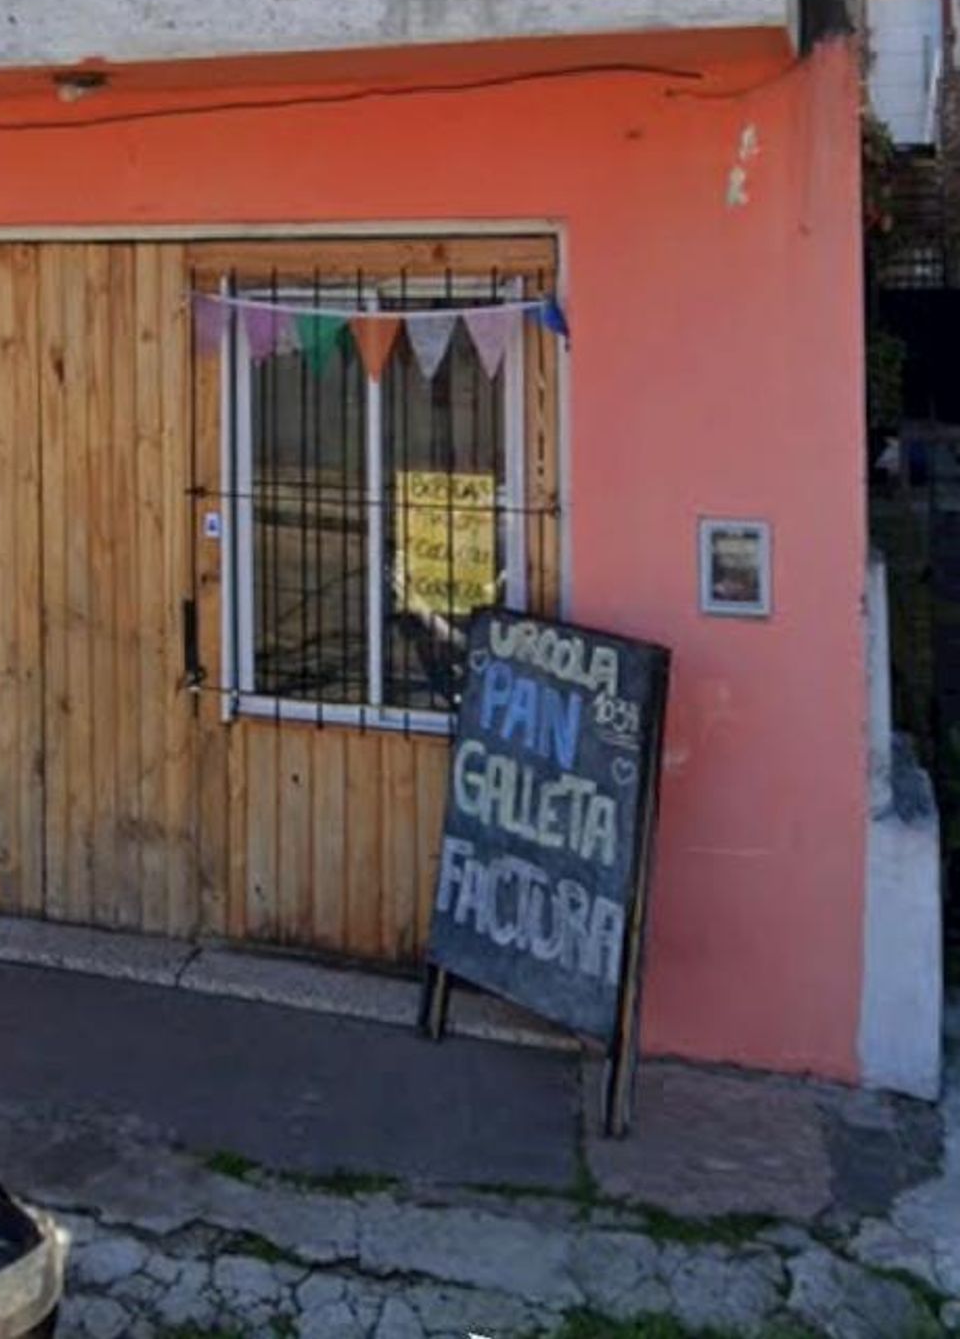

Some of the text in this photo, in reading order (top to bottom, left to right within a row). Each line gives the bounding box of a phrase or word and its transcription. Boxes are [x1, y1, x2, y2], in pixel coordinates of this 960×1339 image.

[480, 660, 584, 770] PAN
[453, 740, 617, 865] GALLETA
[438, 836, 626, 984] FACTURA
